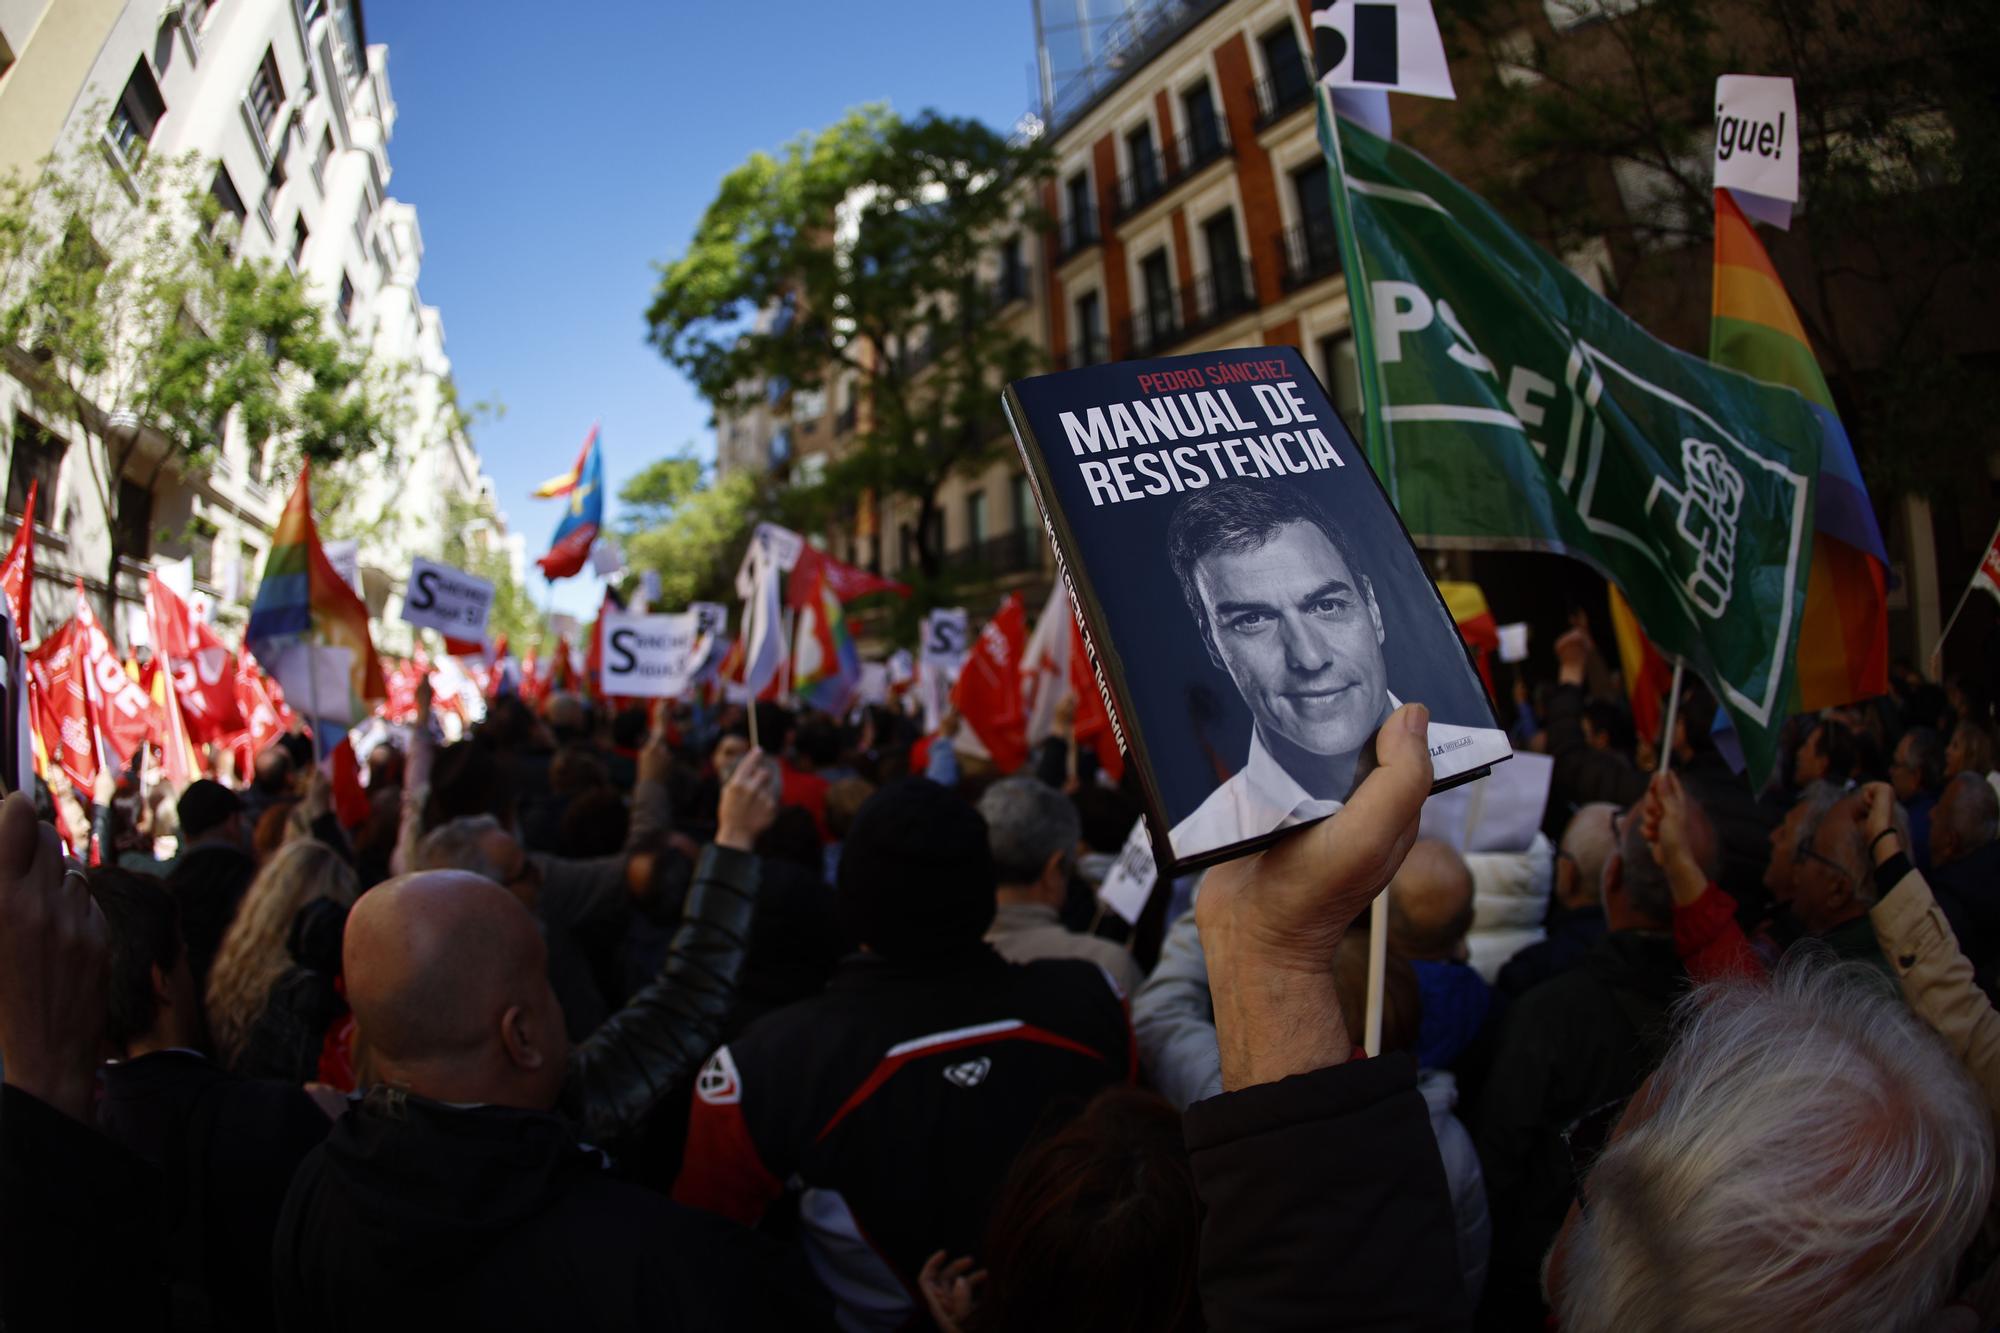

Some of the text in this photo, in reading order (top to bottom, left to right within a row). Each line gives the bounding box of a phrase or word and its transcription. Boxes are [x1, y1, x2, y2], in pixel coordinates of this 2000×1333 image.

[1137, 360, 1292, 394] PEDRO SÁNCHEZ
[1058, 381, 1317, 456] MANUAL DE
[1078, 428, 1345, 506] RESISTENCIA
[1084, 631, 1097, 660] DE
[1095, 661, 1127, 757] MANUAL
